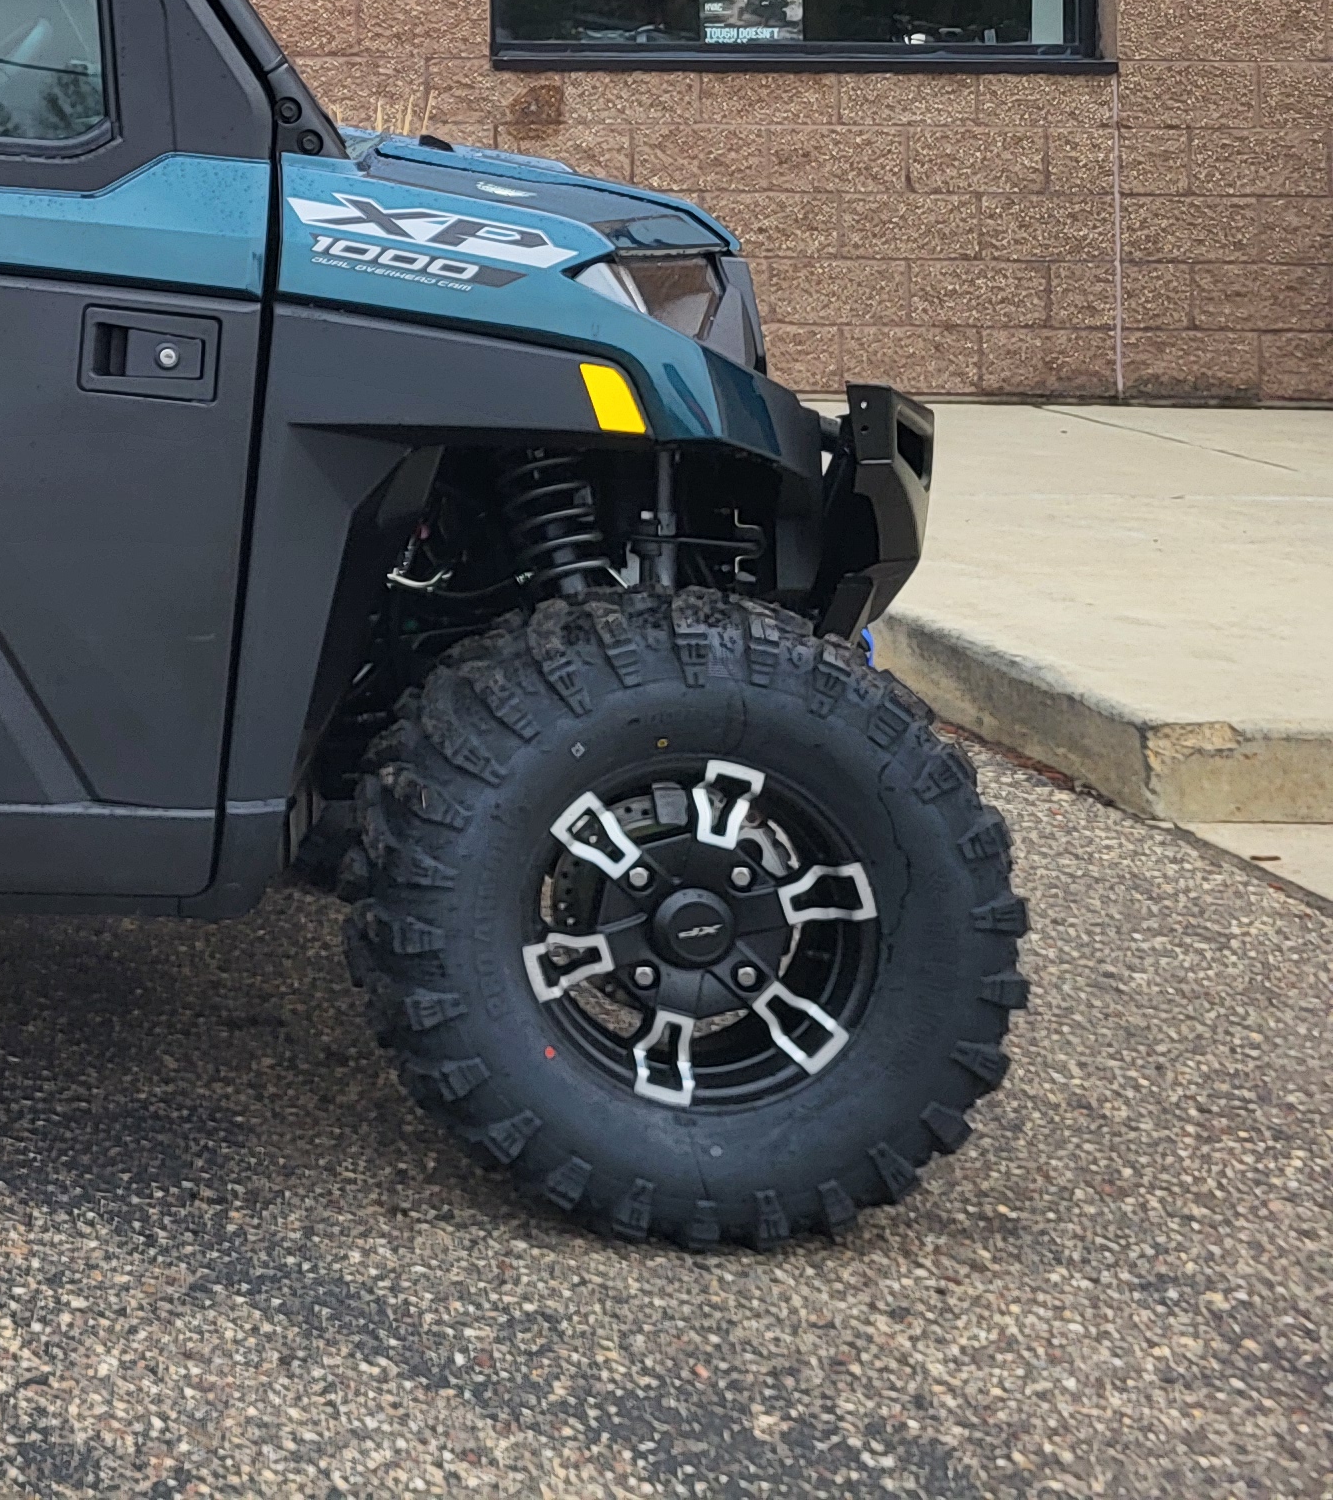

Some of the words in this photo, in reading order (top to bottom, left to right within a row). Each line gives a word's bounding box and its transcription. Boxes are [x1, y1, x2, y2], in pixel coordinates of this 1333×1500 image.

[705, 27, 738, 39] TOUGH
[738, 27, 780, 39] DOESN'T
[301, 193, 553, 250] XP
[310, 235, 480, 281] 1000
[311, 256, 351, 269] DUAL
[355, 264, 436, 285] OVERHEAD
[437, 278, 475, 293] CAM
